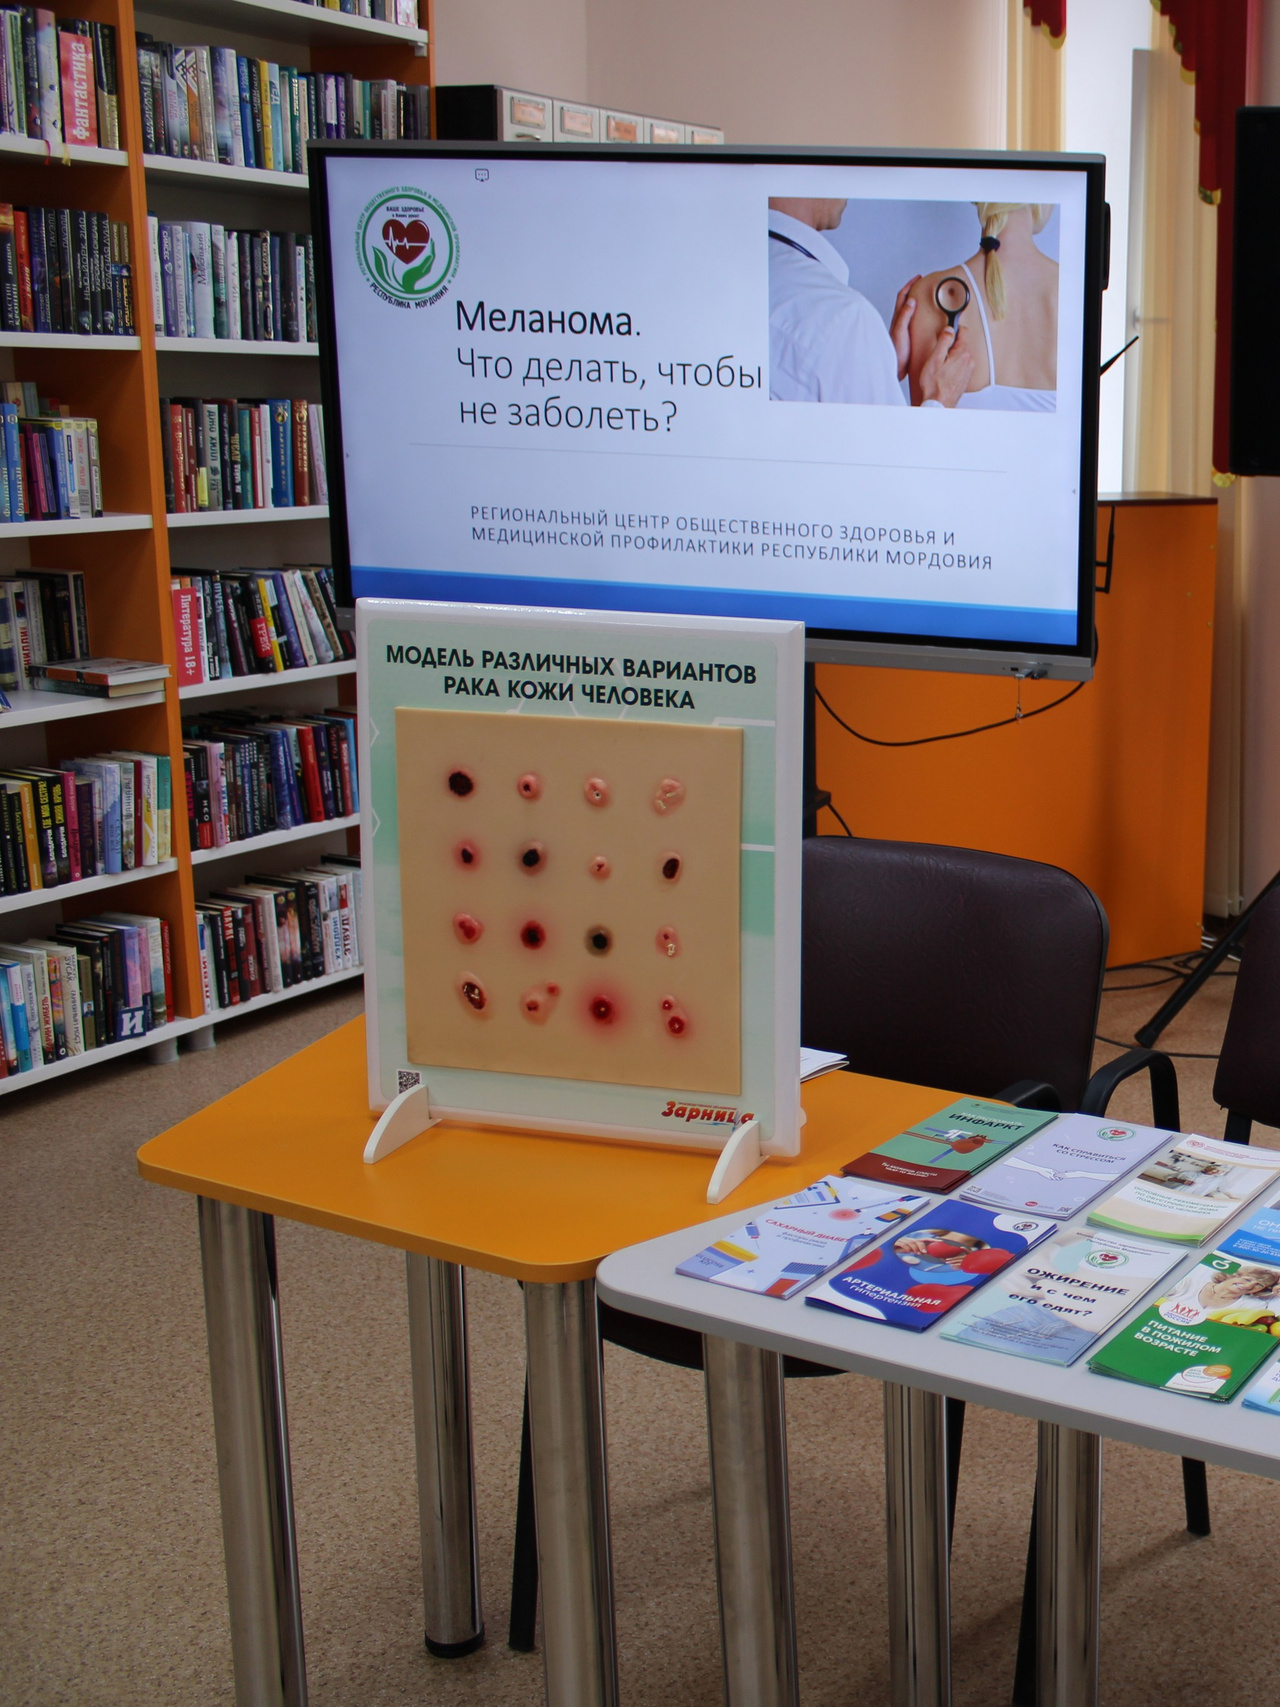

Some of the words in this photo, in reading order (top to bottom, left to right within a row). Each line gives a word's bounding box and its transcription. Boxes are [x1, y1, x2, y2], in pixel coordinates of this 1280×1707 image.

[71, 42, 90, 140] Фантастика
[370, 282, 411, 309] РЕСПУБЛИКА
[414, 285, 449, 309] МОРДОВИЯ
[456, 300, 641, 336] Меланома.
[457, 347, 513, 379] Что
[522, 357, 646, 390] делать,
[658, 355, 762, 388] чтобы
[460, 401, 497, 425] не
[508, 396, 677, 432] заболеть?
[471, 505, 608, 527] РЕГИОНАЛЬНЫЙ
[615, 513, 670, 531] ЦЕНТР
[676, 516, 833, 539] ОБЩЕСТВЕННОГО
[840, 525, 936, 544] ЗДОРОВЬЯ
[943, 532, 955, 546] И
[472, 526, 604, 548] МЕДИЦИНСКОЙ
[611, 534, 754, 556] ПРОФИЛАКТИКИ
[761, 543, 878, 563] РЕСПУБЛИКИ
[886, 550, 992, 570] МОРДОВИЯ
[179, 594, 193, 653] Литература
[185, 656, 196, 676] 18+
[386, 644, 474, 669] МОДЕЛЬ
[482, 650, 615, 676] РАЗЛИЧНЫХ
[623, 658, 757, 685] ВАРИАНТОВ
[443, 676, 500, 697] РАКА
[507, 680, 574, 702] КОЖИ
[582, 684, 695, 709] ЧЕЛОВЕКА
[121, 1009, 145, 1036] И
[661, 1100, 755, 1124] Зарница
[948, 1113, 1025, 1131] ИНФАРКТ
[1052, 1143, 1070, 1151] КАК
[1071, 1148, 1126, 1161] СПРАВИТЬСЯ
[1069, 1152, 1115, 1164] СТРЕССОМ
[765, 1218, 816, 1238] САХАРНЫЙ
[813, 1231, 852, 1243] ДИАБЕТ
[842, 1276, 942, 1306] АРТЕРИАЛЬНАЯ
[1027, 1267, 1130, 1296] ОЖИРЕНИЕ
[1030, 1283, 1043, 1292] и
[1046, 1287, 1058, 1296] с
[1063, 1292, 1097, 1305] чем
[1008, 1292, 1038, 1306] его
[1042, 1300, 1094, 1318] едят?
[1133, 1332, 1199, 1357] ВОЗРАСТЕ
[1140, 1326, 1151, 1334] В
[1151, 1329, 1222, 1354] ПОЖИЛОМ
[1147, 1319, 1208, 1343] ПИТАНИЕ
